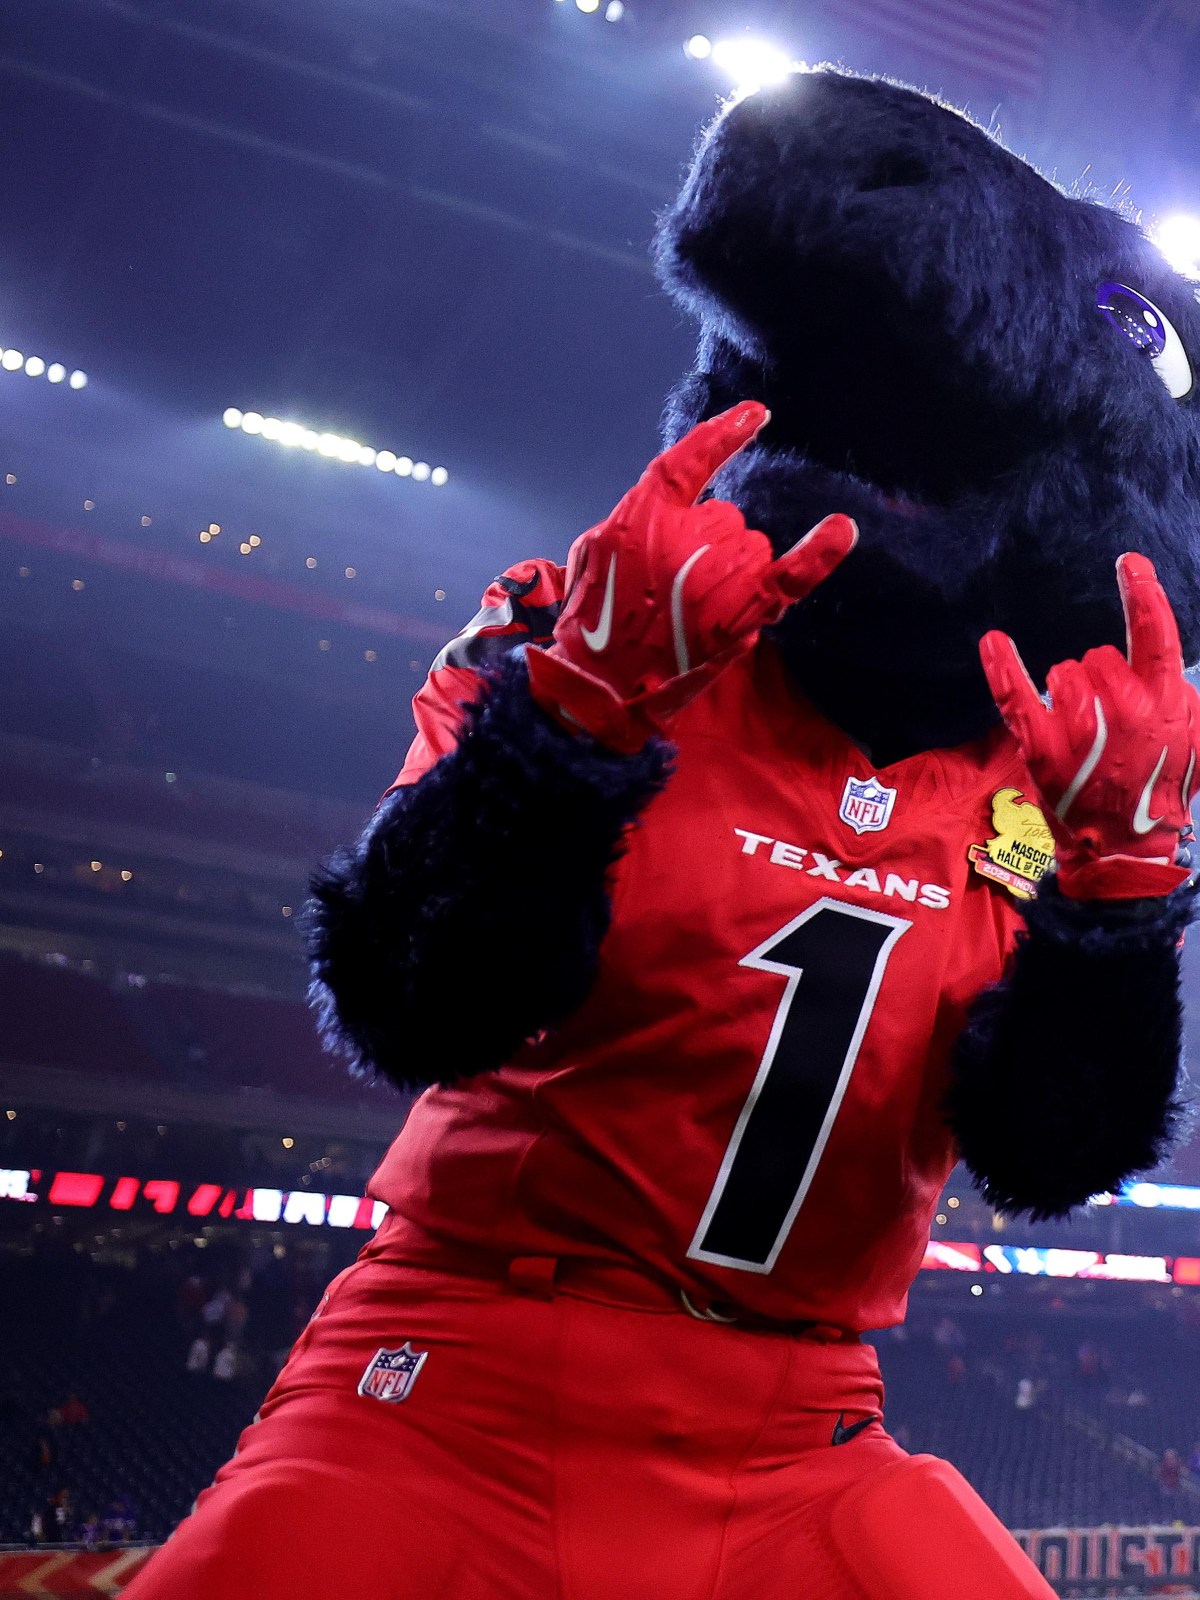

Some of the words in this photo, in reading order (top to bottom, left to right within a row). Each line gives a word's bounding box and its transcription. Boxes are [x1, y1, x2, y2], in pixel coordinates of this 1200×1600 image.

[847, 798, 882, 824] NFL
[734, 828, 951, 910] TEXANS
[982, 863, 1011, 882] 2025
[997, 848, 1021, 870] HALL
[686, 896, 913, 1275] 1
[368, 1369, 403, 1397] NFL
